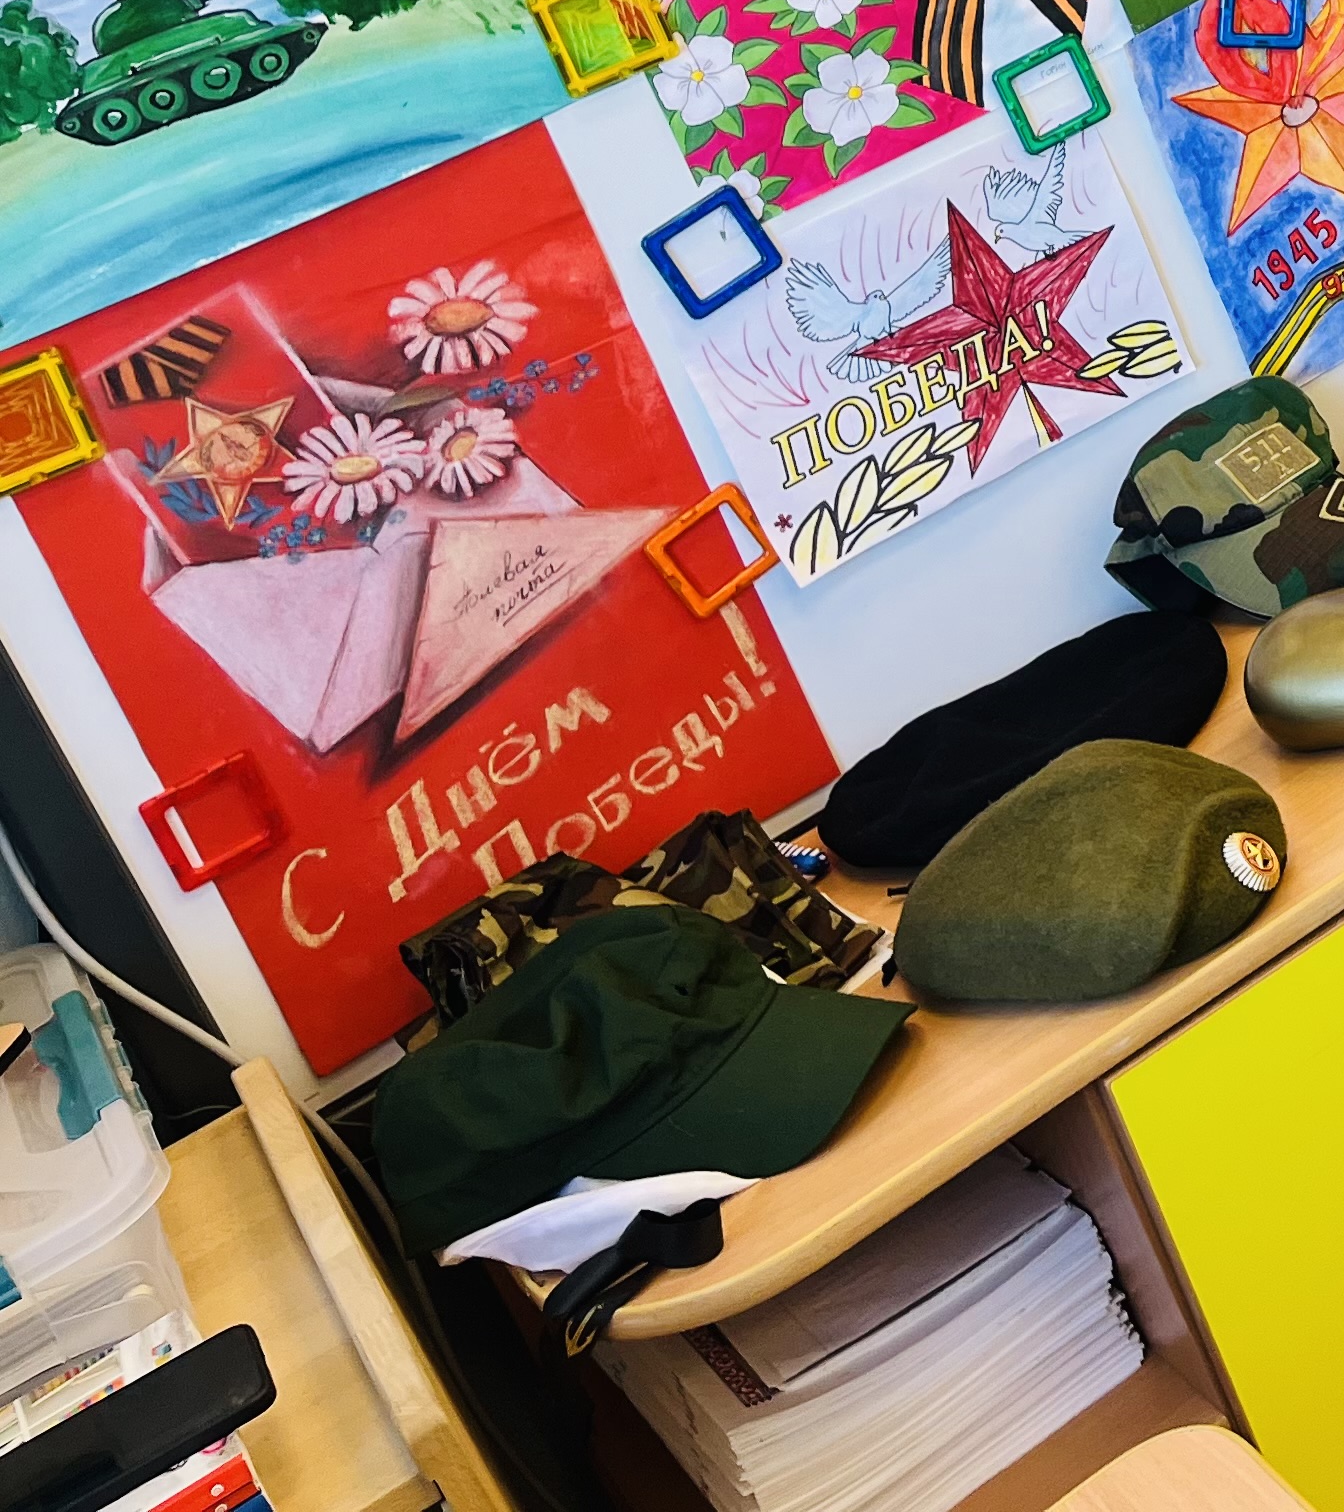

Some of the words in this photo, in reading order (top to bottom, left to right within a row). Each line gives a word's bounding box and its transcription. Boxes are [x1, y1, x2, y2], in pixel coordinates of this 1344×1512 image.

[1252, 208, 1338, 301] 1945
[770, 299, 1056, 490] ПОБЕДА!
[1237, 433, 1292, 473] 5.11
[281, 846, 345, 950] С
[386, 687, 612, 904] Днём
[472, 599, 778, 891] Победы!
